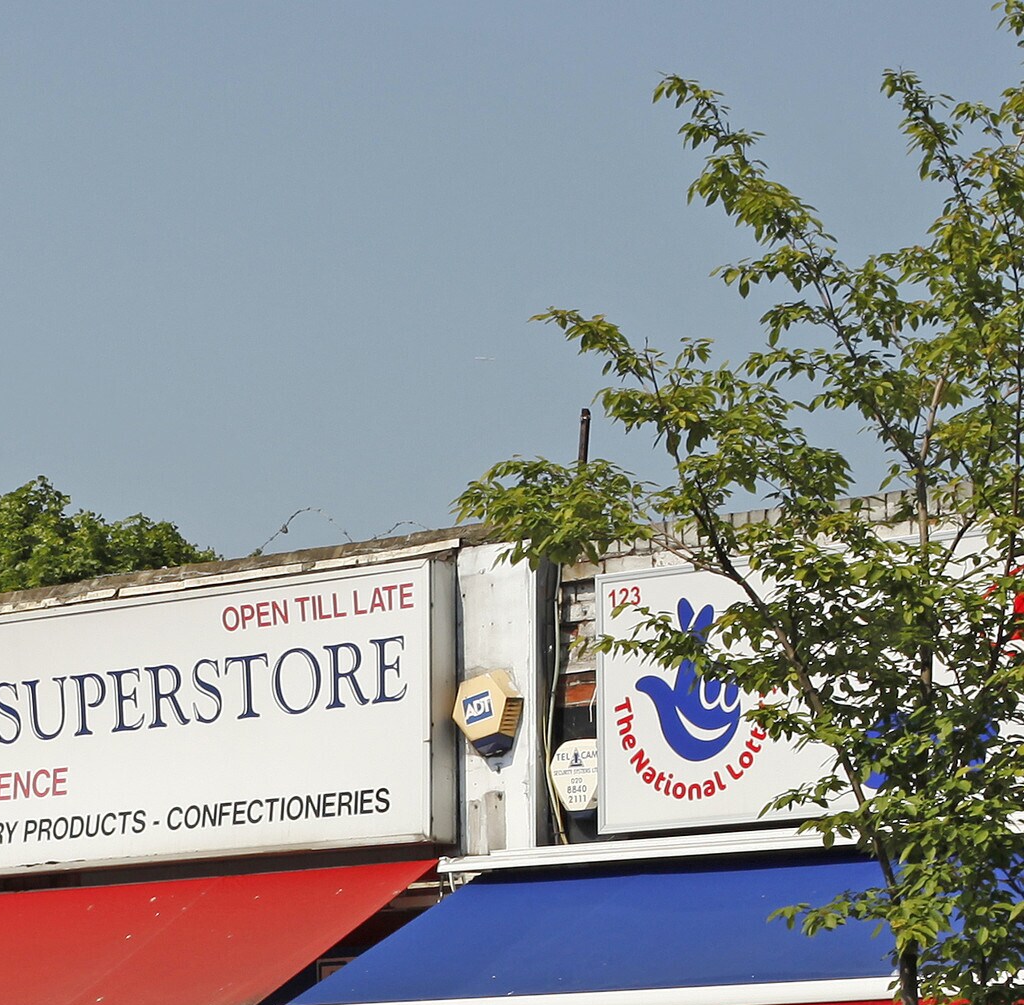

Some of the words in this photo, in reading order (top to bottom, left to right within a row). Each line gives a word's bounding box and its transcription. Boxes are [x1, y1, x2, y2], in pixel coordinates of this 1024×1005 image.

[221, 600, 289, 631] OPEN
[294, 593, 347, 623] TILL
[353, 583, 415, 616] LATE
[608, 586, 641, 608] 123
[465, 696, 492, 720] ADT
[556, 752, 571, 761] TEL
[614, 696, 637, 751] The
[629, 748, 727, 801] National
[726, 707, 772, 780] Lott
[566, 784, 588, 794] 8840
[568, 795, 587, 803] 2111
[23, 809, 147, 844] PRODUCTS
[166, 787, 391, 831] CONFECTIONERIES
